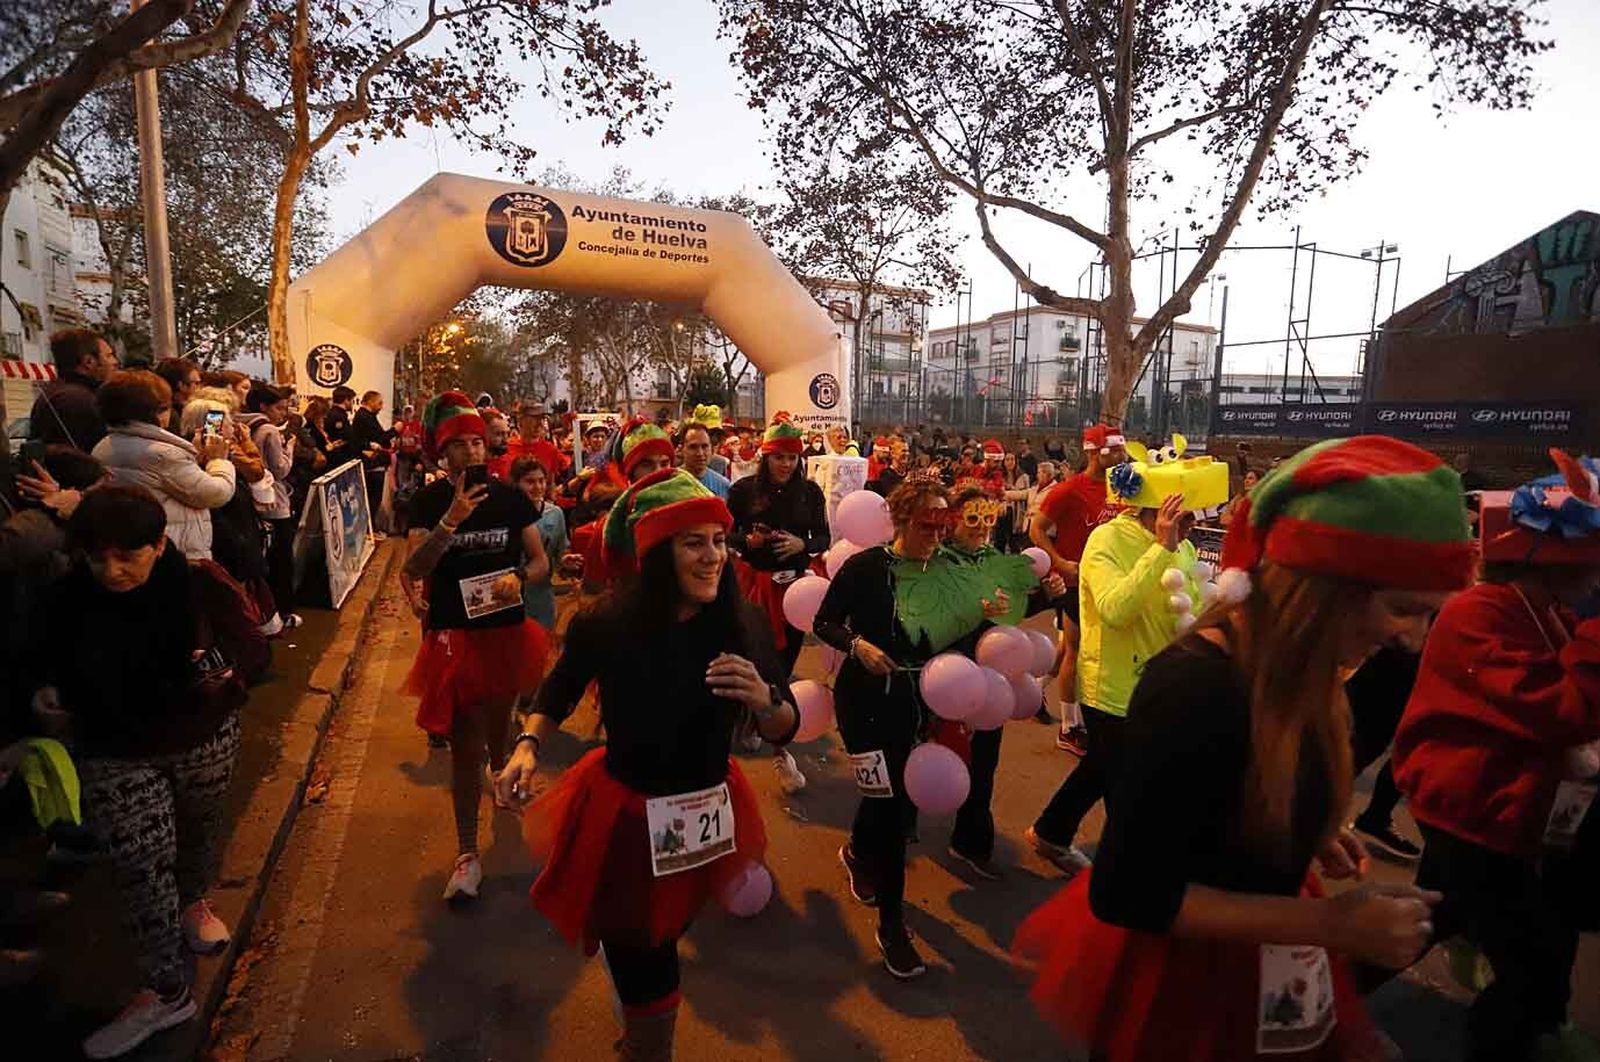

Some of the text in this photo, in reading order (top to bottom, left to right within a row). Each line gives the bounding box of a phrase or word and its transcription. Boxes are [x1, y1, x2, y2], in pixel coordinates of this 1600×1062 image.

[571, 205, 707, 233] Ayuntamiento
[612, 226, 707, 249] de Huelva
[642, 248, 656, 258] de
[660, 250, 709, 264] Deportes
[1237, 411, 1276, 420] HYUNDAI
[1306, 411, 1352, 420] HYUNDAI
[1400, 411, 1457, 420] HYUNDAI
[1500, 410, 1570, 421] HYUNDAI
[699, 808, 720, 843] 21
